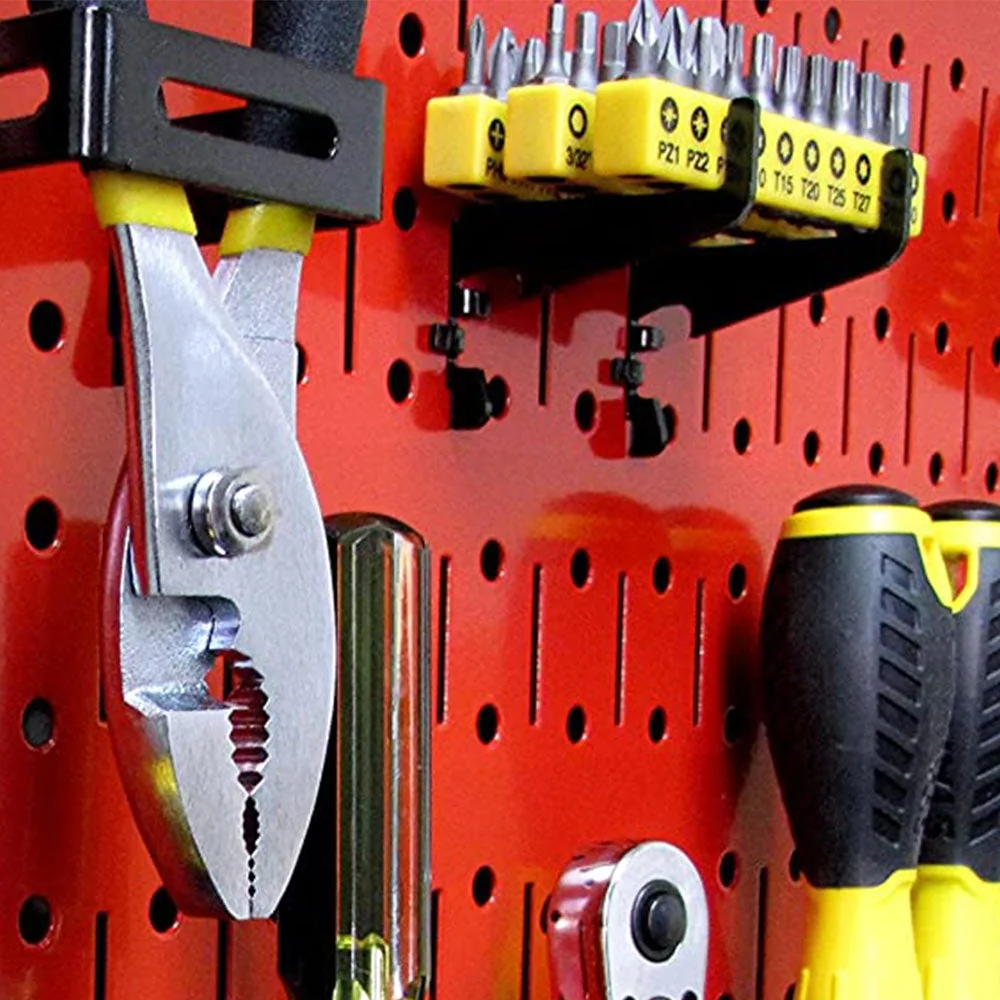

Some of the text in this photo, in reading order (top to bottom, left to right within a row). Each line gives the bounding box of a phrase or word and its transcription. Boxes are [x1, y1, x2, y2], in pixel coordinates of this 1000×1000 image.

[658, 140, 680, 166] PZ1
[686, 148, 710, 173] PZ2
[774, 169, 794, 195] T15
[801, 177, 820, 202] T20
[828, 185, 847, 208] T25
[853, 191, 871, 214] T27
